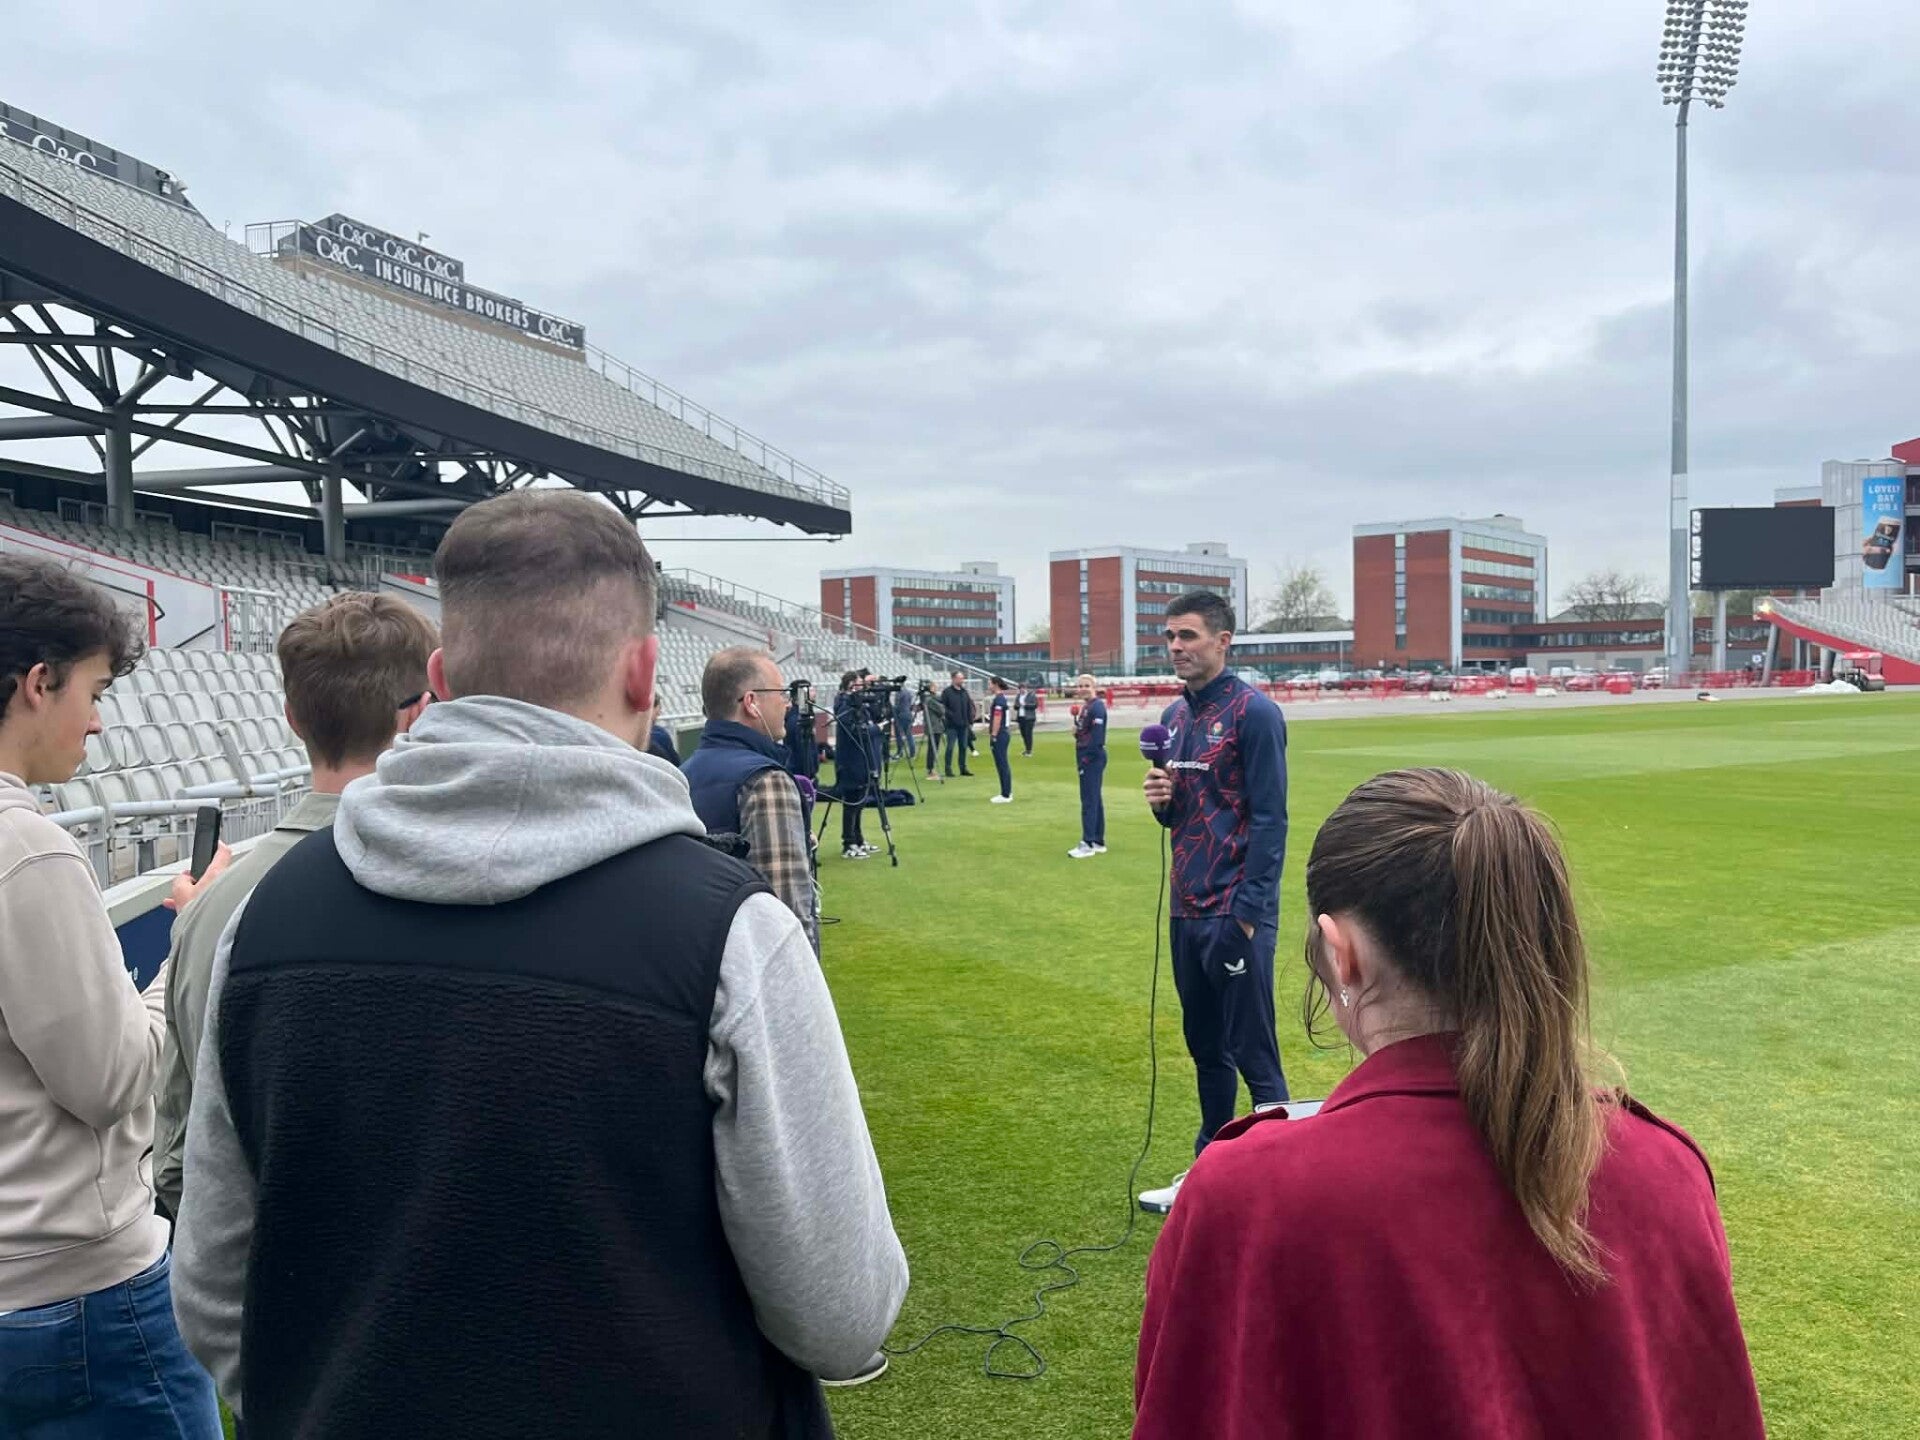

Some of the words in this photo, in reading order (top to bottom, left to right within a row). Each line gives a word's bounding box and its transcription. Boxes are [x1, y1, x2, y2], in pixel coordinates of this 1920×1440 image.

[375, 258, 460, 306] INSURANCE
[466, 292, 530, 328] BROKERS
[1868, 485, 1900, 494] LOVELY
[1877, 494, 1895, 503] DAY
